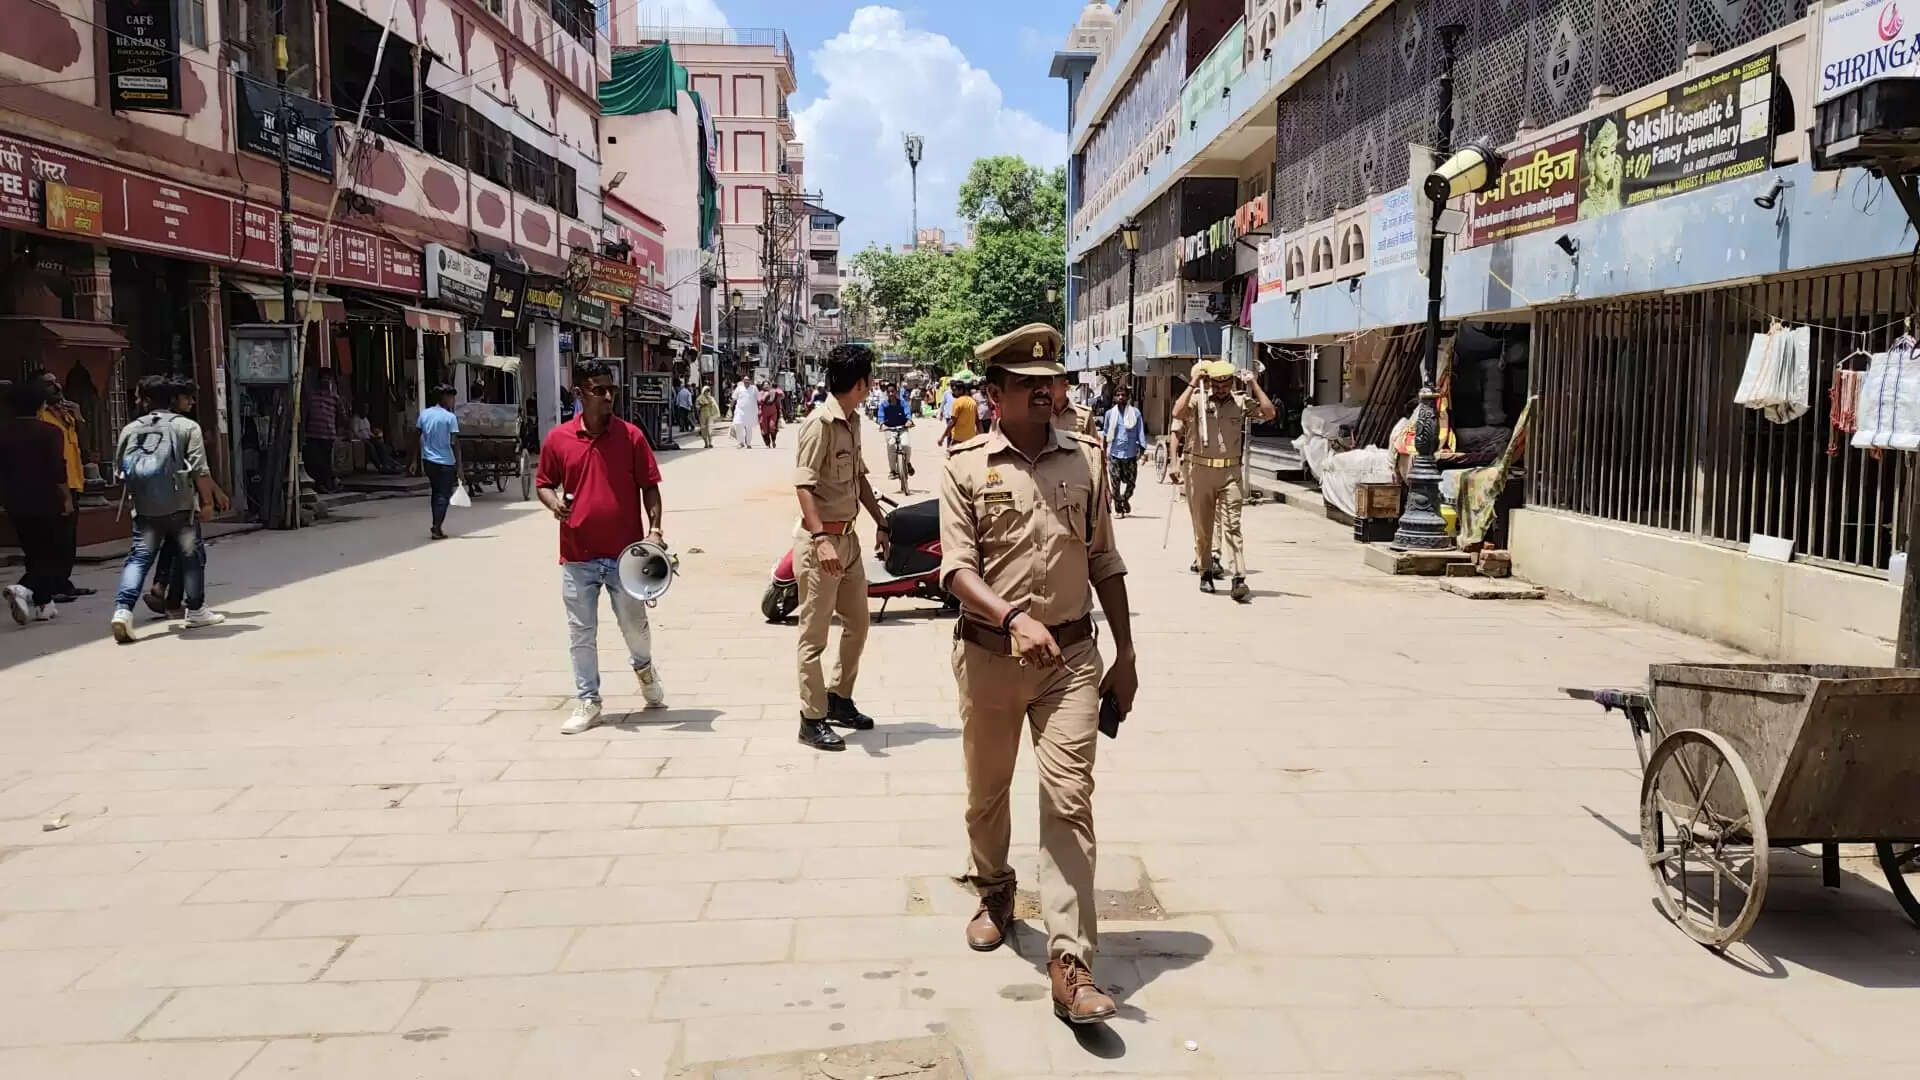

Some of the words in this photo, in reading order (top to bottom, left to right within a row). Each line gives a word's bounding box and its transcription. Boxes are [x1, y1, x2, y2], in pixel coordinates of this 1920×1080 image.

[116, 37, 167, 48] BENARAS
[1626, 105, 1675, 151] Sakshi
[1675, 100, 1722, 136] Cosmetic
[1726, 93, 1734, 119] &
[1652, 141, 1682, 167] Fancy
[1684, 124, 1741, 156] Jewellery
[1705, 167, 1721, 185] HAIR
